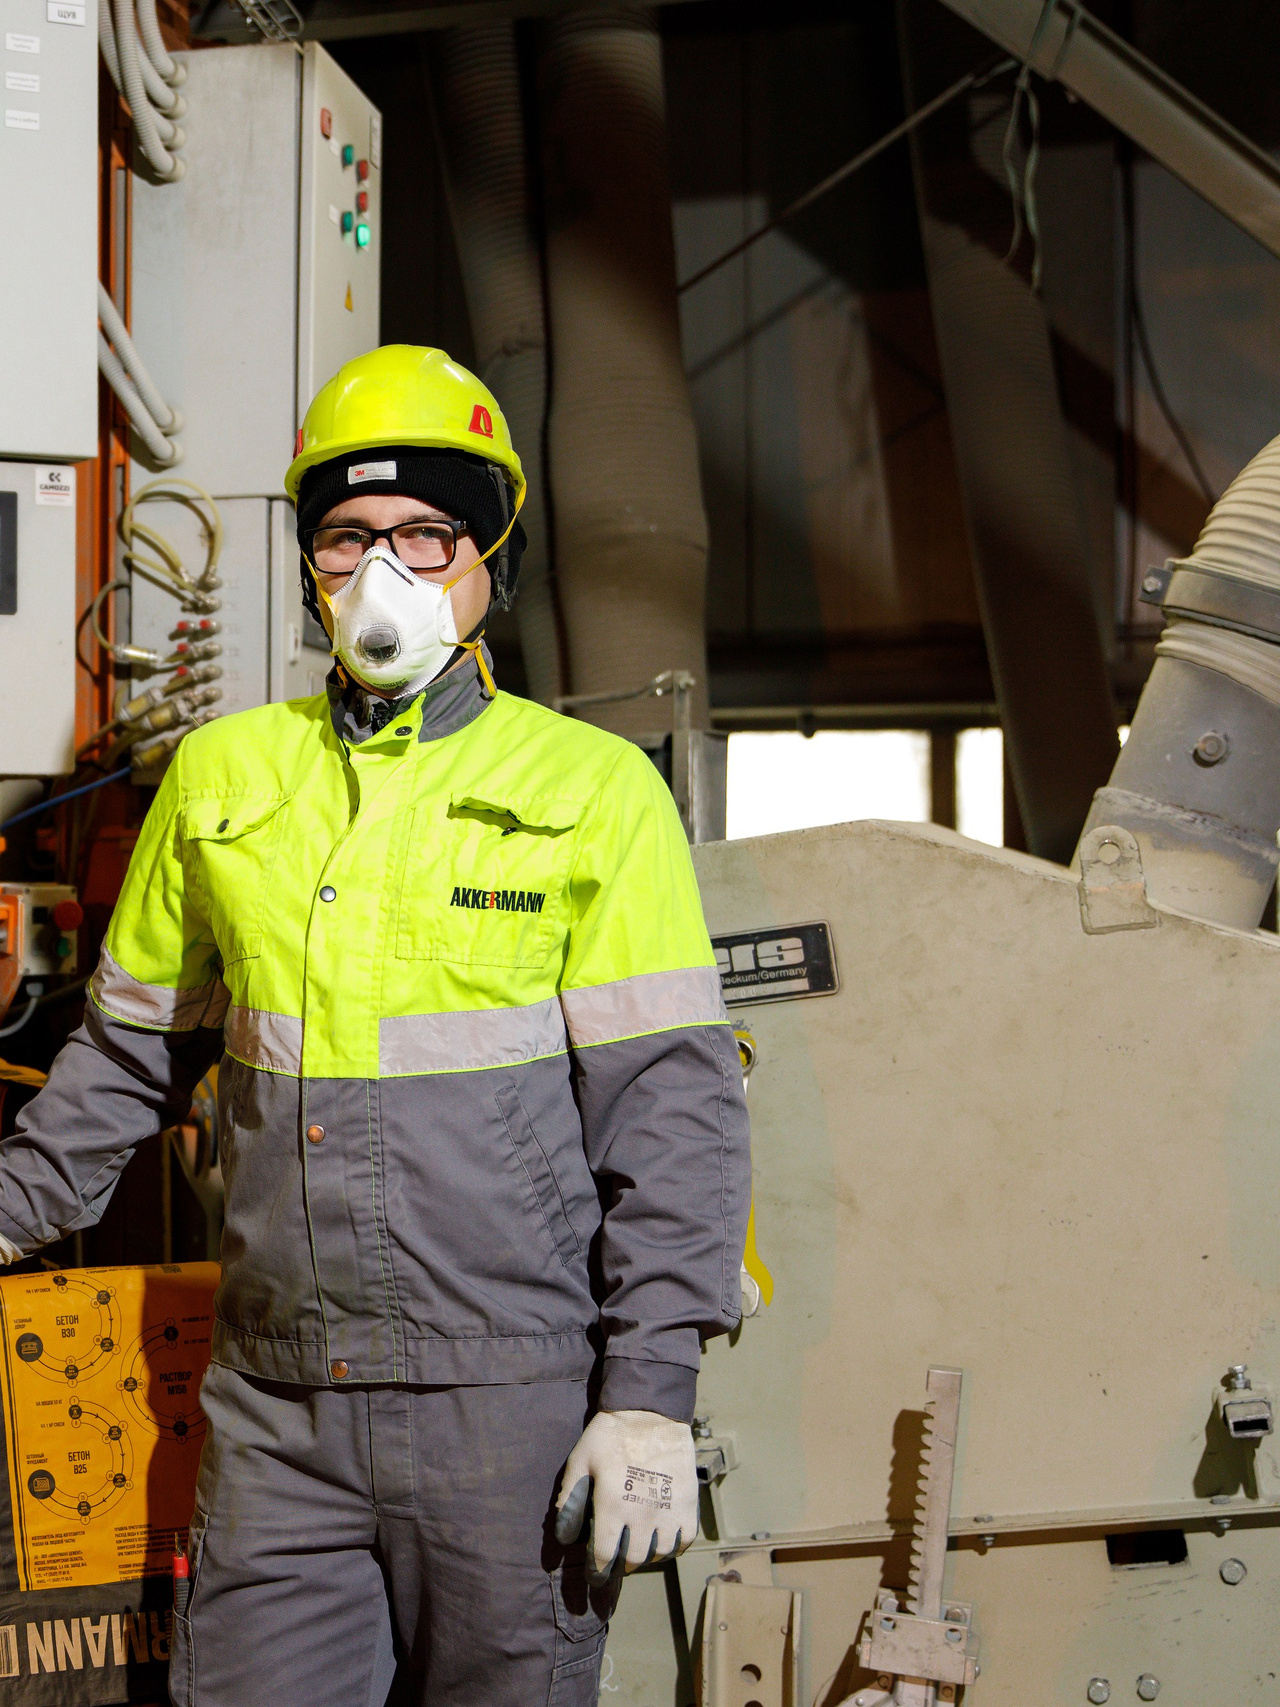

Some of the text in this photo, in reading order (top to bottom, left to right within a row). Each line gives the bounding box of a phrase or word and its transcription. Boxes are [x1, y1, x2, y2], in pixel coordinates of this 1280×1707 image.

[450, 886, 546, 913] AKKERMANN
[55, 1315, 79, 1326] БЕТОН
[160, 1371, 192, 1383] РАСТВОР
[68, 1451, 91, 1462] БЕТОН
[624, 1479, 633, 1491] 9
